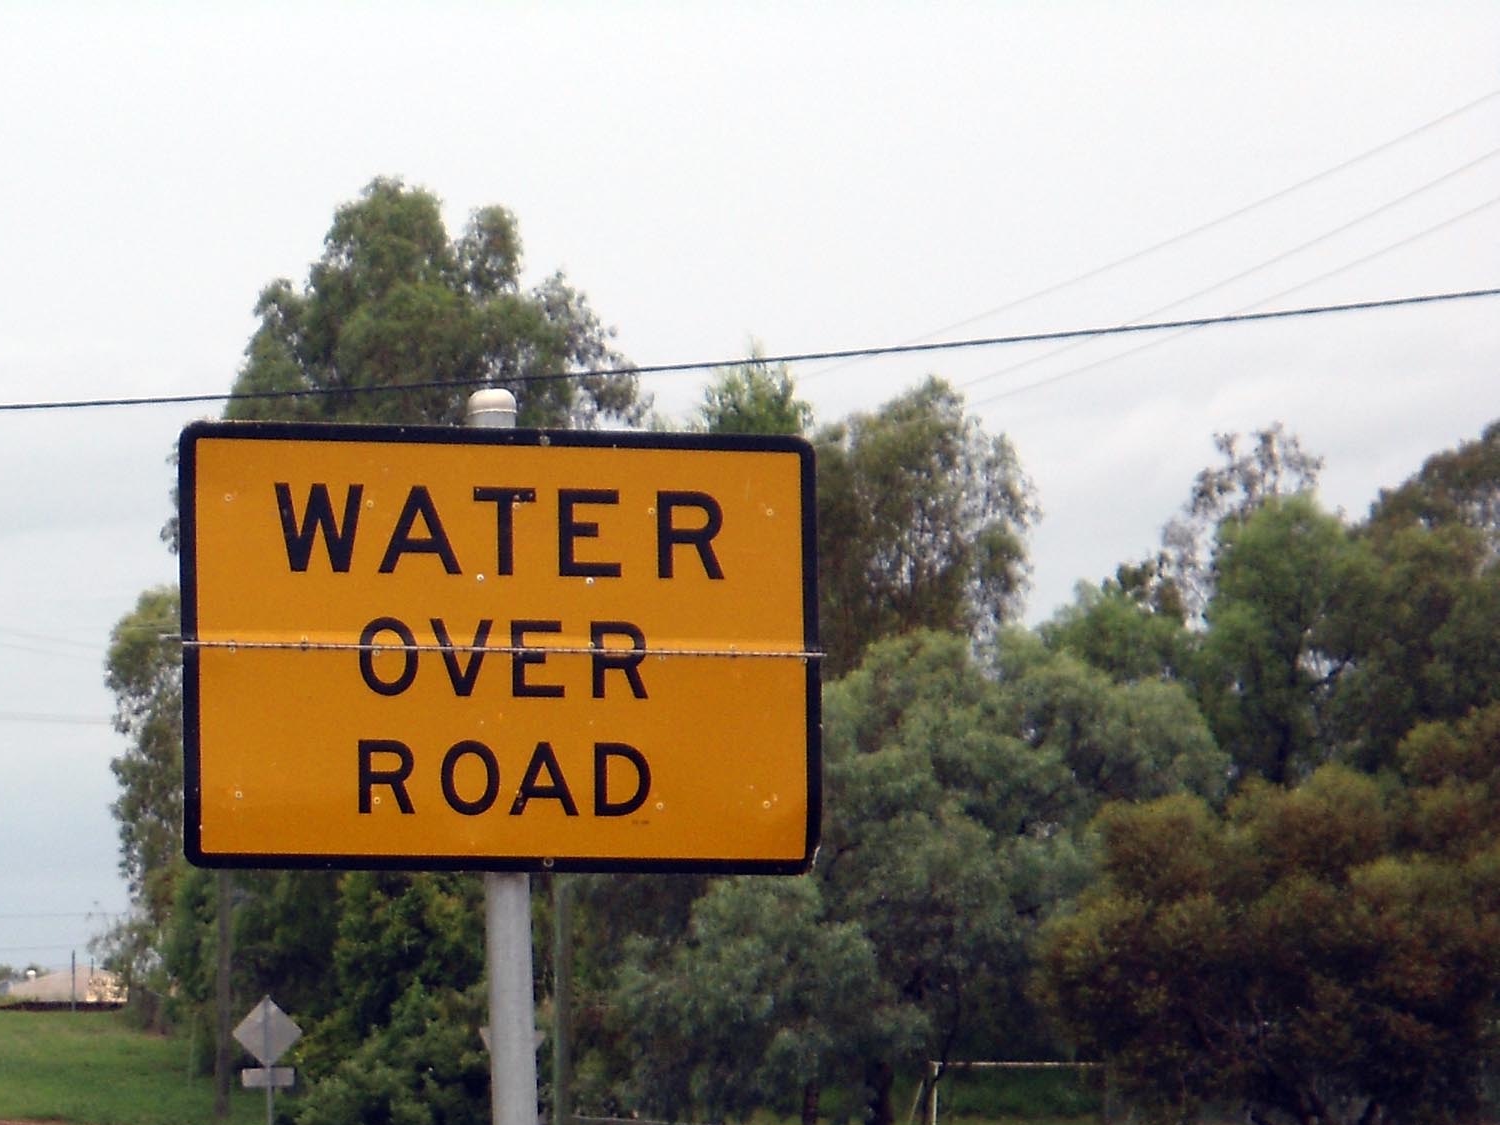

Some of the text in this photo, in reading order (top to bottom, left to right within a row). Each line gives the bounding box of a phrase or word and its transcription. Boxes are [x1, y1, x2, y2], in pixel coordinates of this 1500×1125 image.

[274, 481, 725, 581] WATER
[359, 616, 649, 700] OVER
[357, 739, 652, 817] ROAD
